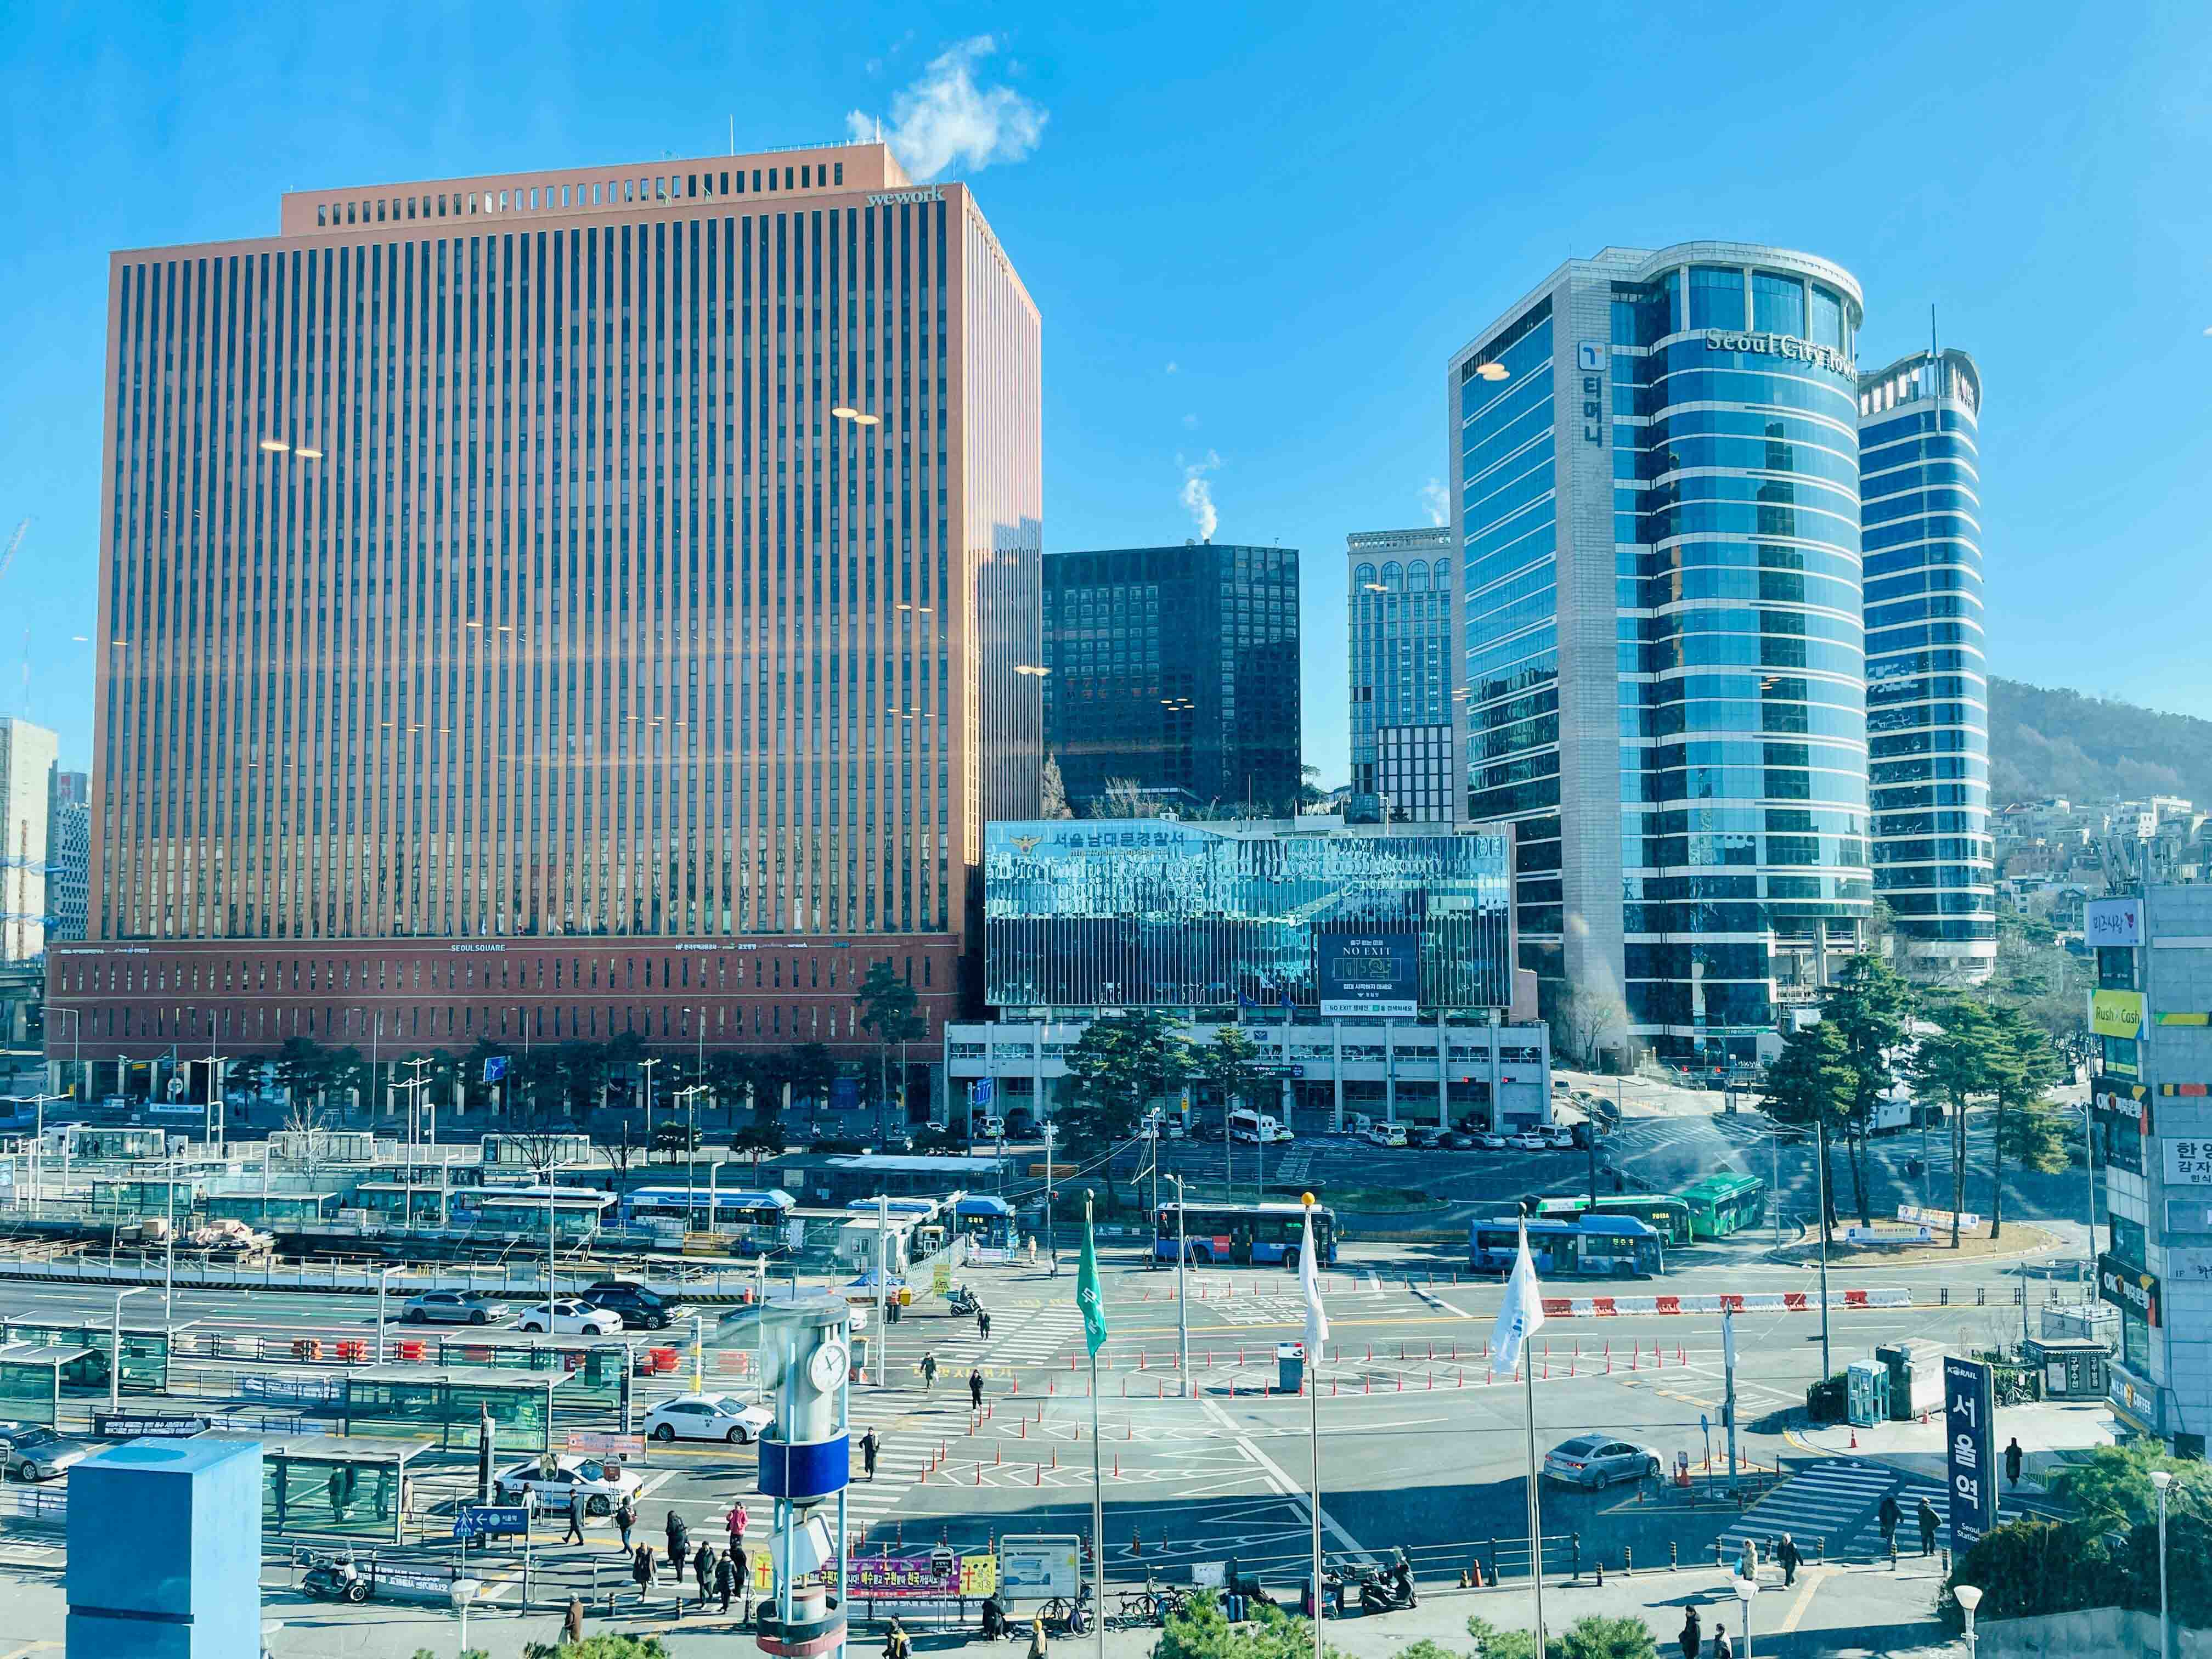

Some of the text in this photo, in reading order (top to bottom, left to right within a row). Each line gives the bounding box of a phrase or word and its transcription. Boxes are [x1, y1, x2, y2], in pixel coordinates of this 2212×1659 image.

[867, 187, 945, 206] wework
[1706, 328, 1774, 354] Seoul
[1781, 335, 1822, 368] City
[1584, 375, 1602, 448] 티머니
[1054, 832, 1185, 848] 서울남대문경찰서
[1343, 947, 1392, 955] NO EXIT
[2096, 1006, 2140, 1024] Rush Cash
[1948, 1366, 1977, 1380] KORAIL
[1953, 1394, 1979, 1510] 서울역
[1961, 1522, 1979, 1534] Seoul
